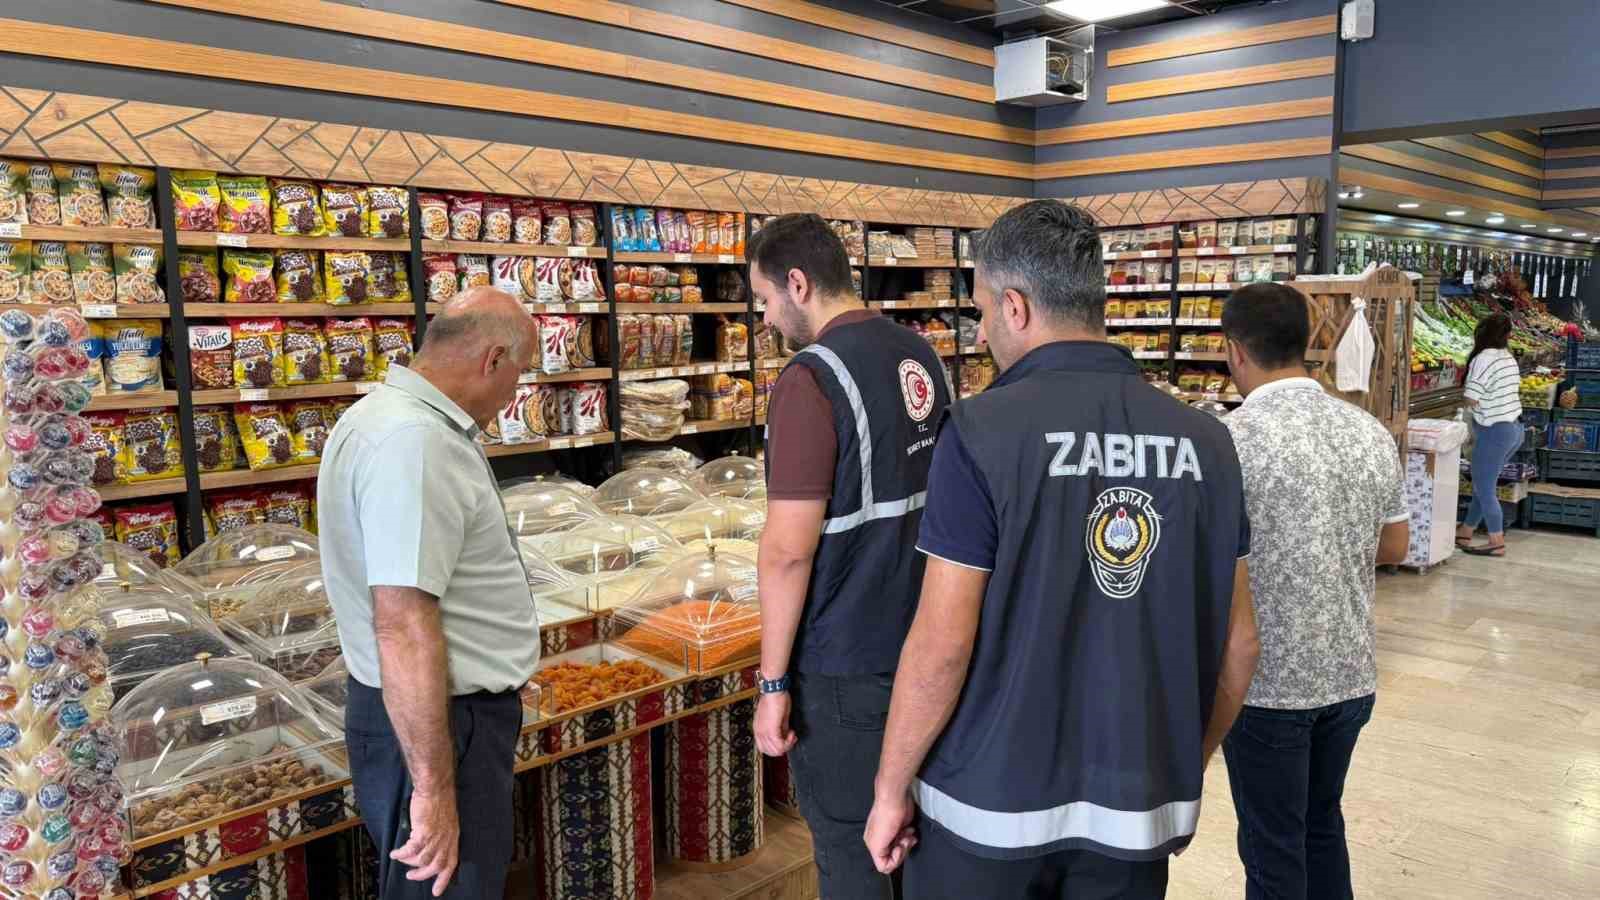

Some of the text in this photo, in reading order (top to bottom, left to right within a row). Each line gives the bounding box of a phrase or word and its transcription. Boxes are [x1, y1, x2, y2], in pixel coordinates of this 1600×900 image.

[546, 326, 566, 355] K
[1045, 431, 1203, 481] ZABITA
[1102, 491, 1143, 508] ZABITA
